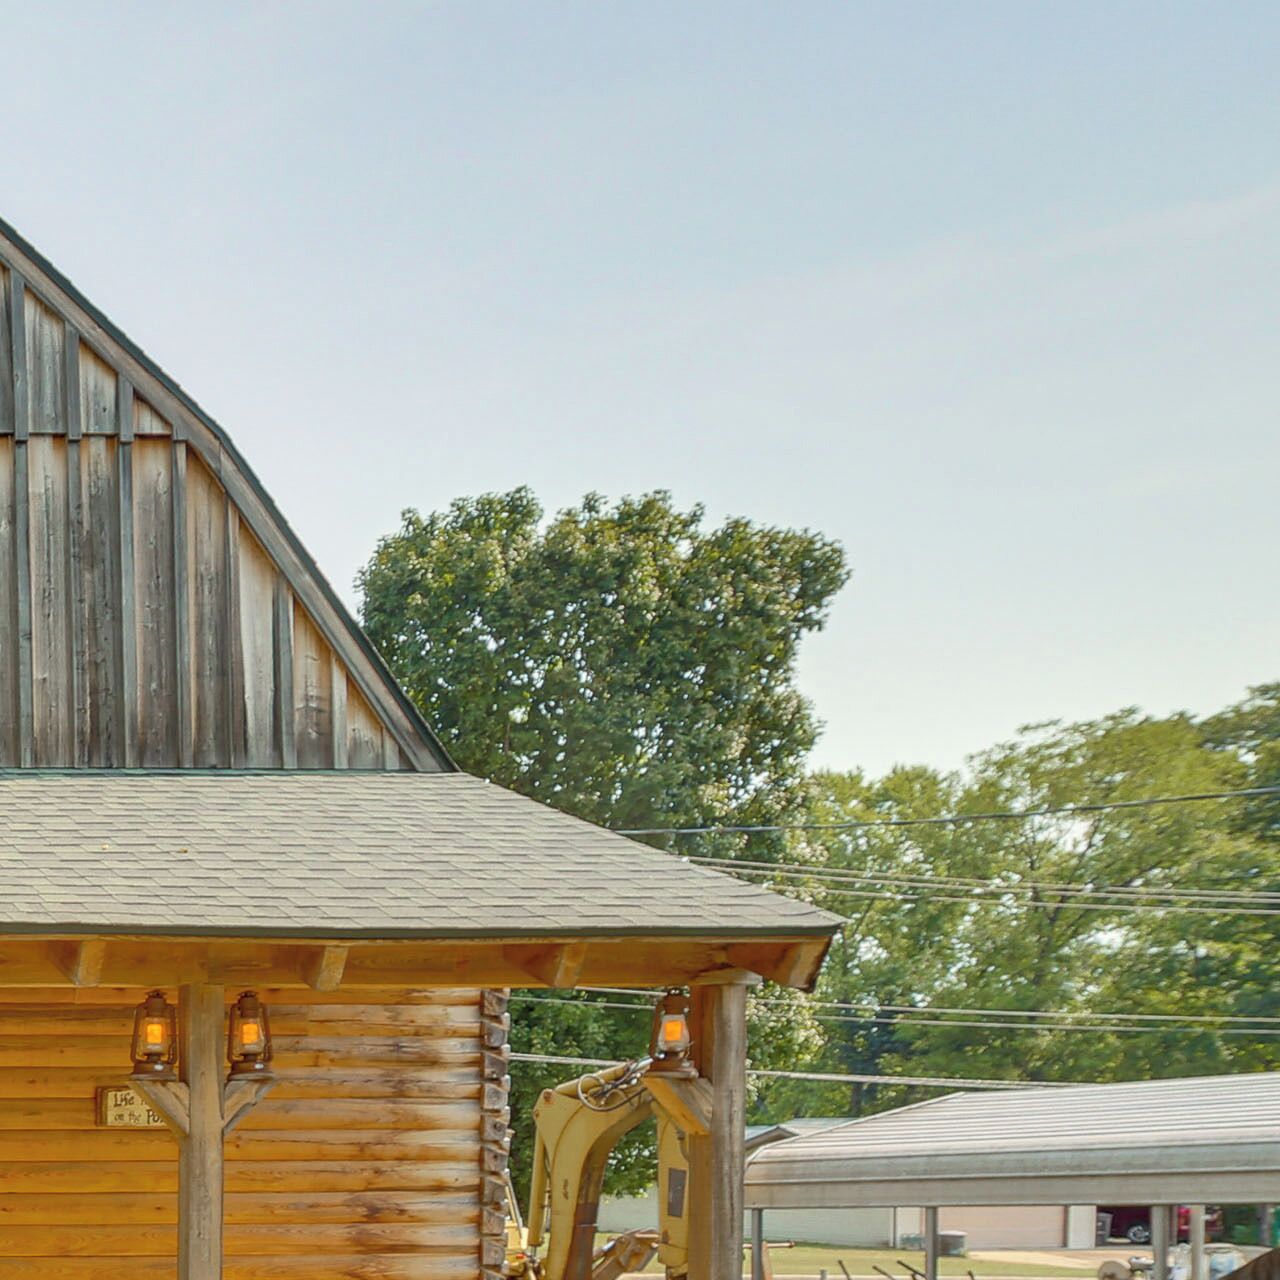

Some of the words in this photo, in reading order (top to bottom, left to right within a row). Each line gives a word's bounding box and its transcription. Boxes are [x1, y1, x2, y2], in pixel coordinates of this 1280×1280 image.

[113, 1092, 135, 1107] Life
[114, 1113, 124, 1121] on
[128, 1110, 142, 1123] the
